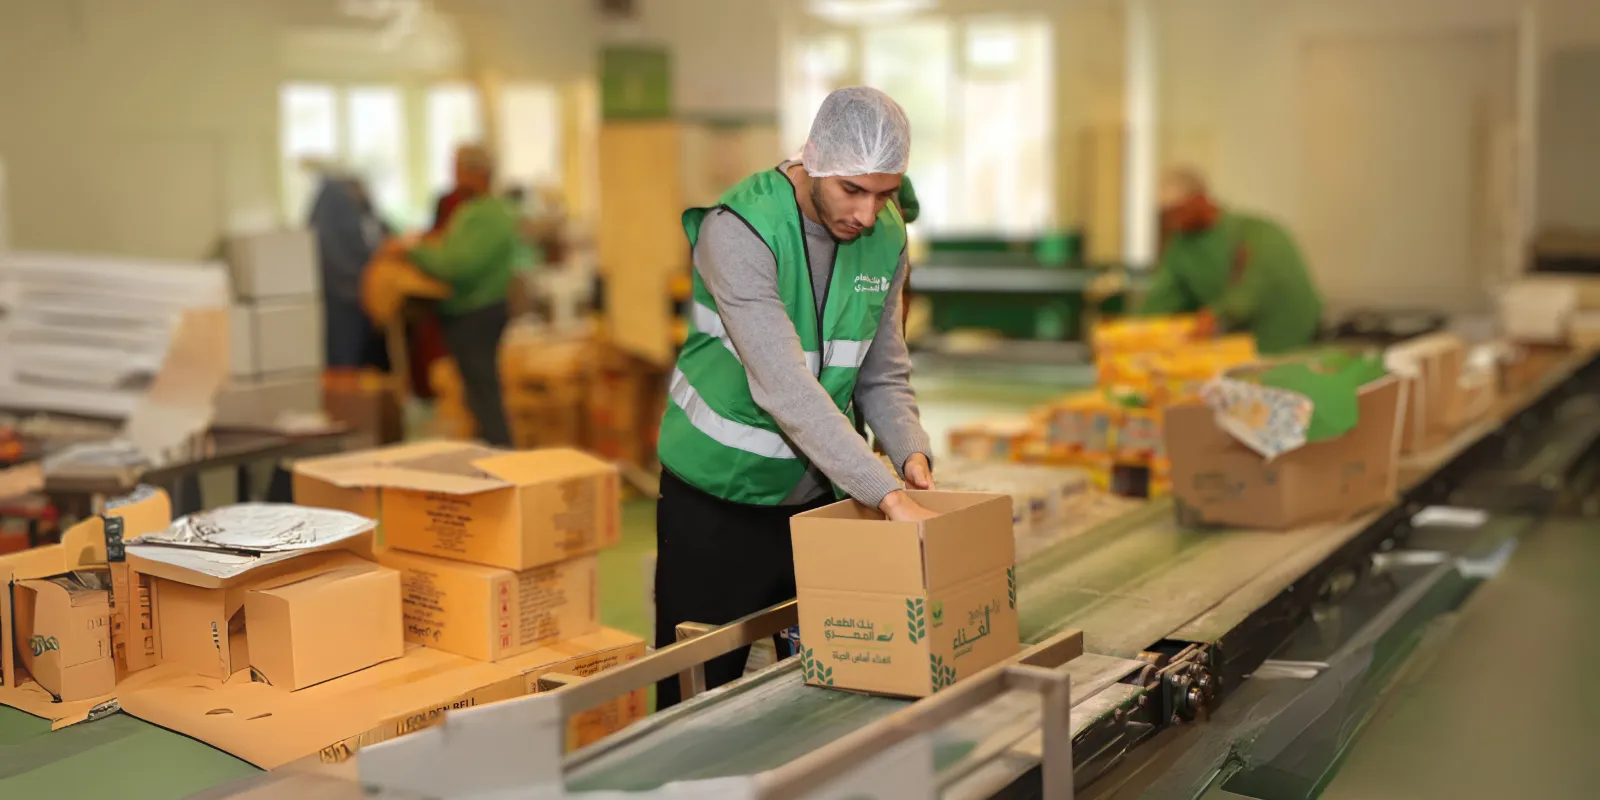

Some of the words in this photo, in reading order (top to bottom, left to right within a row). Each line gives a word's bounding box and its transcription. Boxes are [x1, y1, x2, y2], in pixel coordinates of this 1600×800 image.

[824, 617, 855, 628] الطعام
[857, 619, 874, 629] بنك
[825, 630, 874, 641] المصري
[832, 650, 850, 662] الحياة
